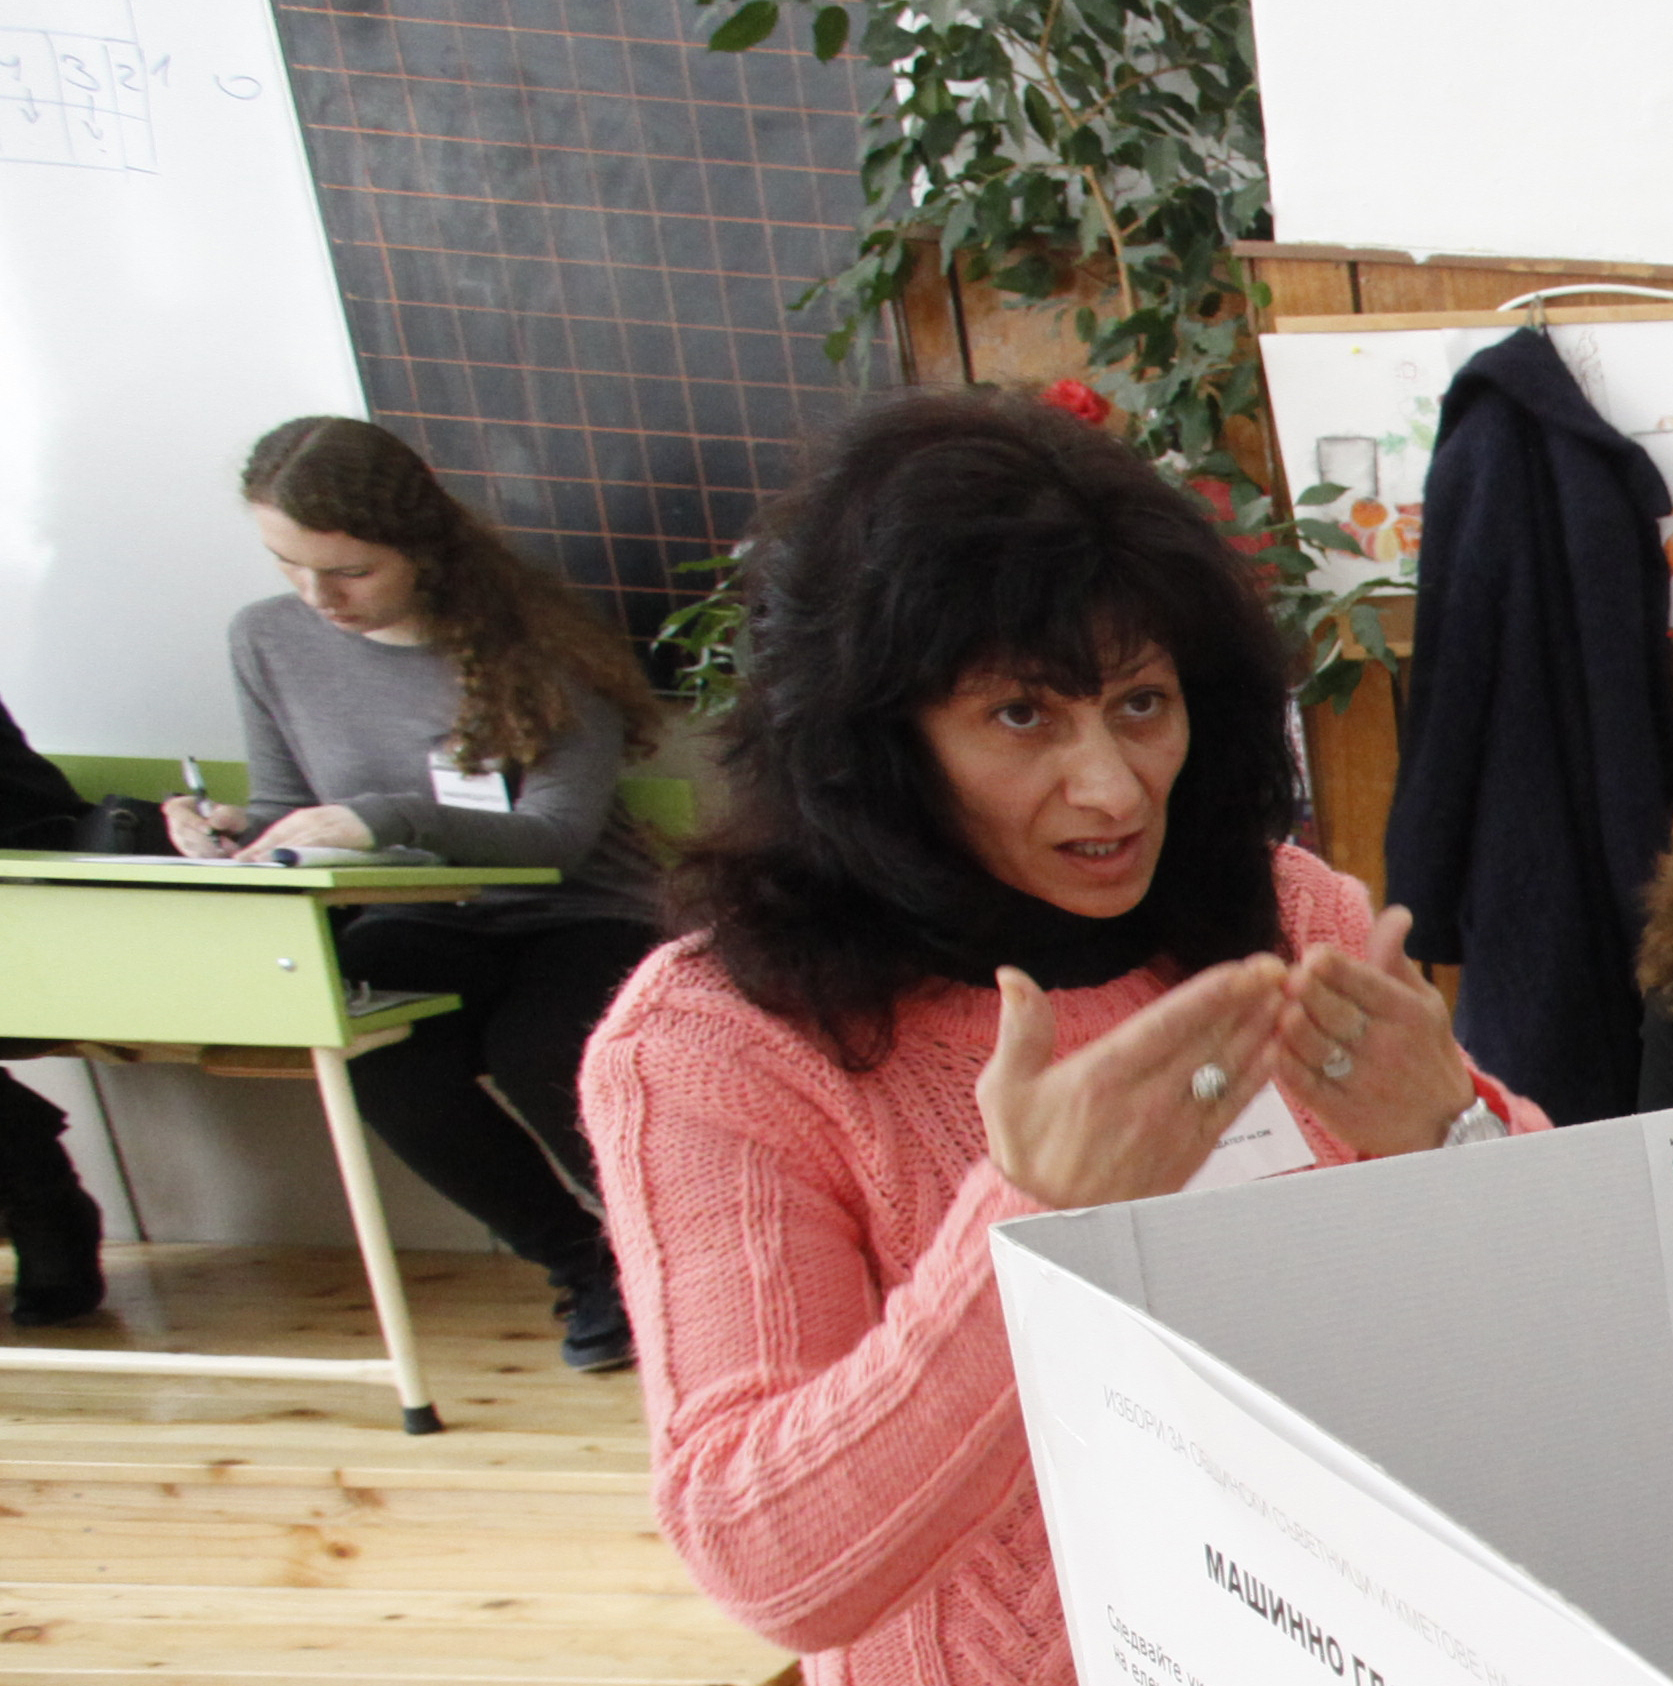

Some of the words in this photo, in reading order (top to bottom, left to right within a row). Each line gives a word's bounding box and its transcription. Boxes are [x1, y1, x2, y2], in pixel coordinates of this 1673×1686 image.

[62, 54, 100, 91] 3
[117, 64, 143, 92] 2
[1203, 1541, 1344, 1677] МАШИННО
[1107, 1604, 1183, 1683] Следвайте
[1113, 1644, 1128, 1672] на
